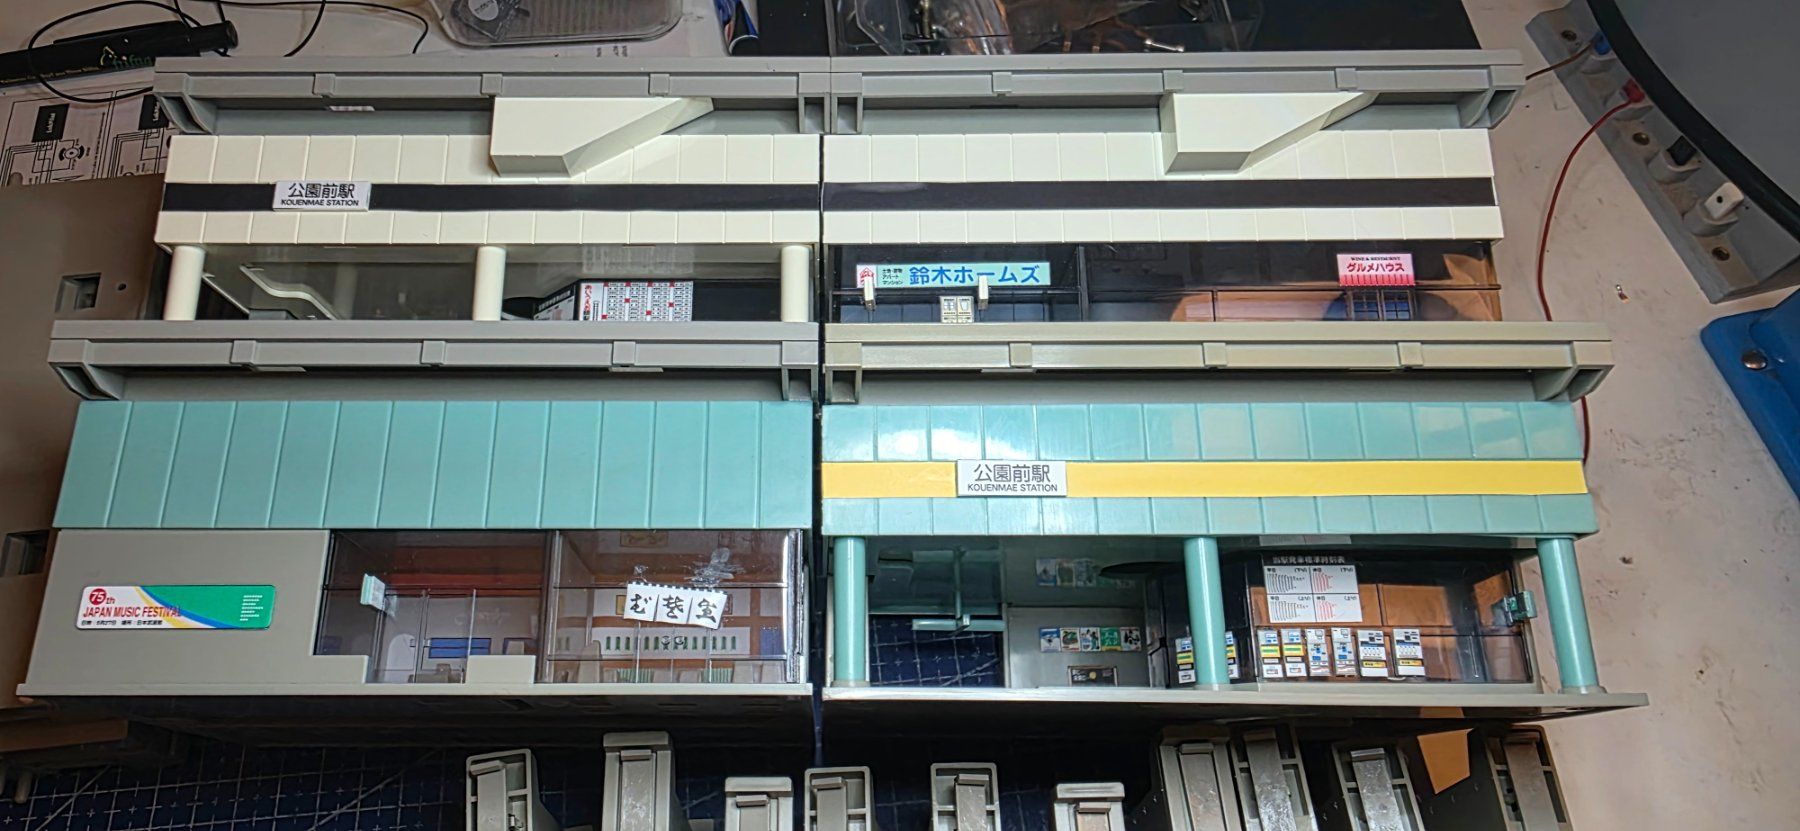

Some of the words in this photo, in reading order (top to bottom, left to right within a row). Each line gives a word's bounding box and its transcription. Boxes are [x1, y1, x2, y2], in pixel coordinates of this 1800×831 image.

[288, 182, 355, 199] 公園前駅
[1346, 262, 1405, 272] グルメハウス
[909, 265, 1040, 286] 鈴木ホームズ
[973, 463, 1051, 483] 公園前駅
[967, 483, 1018, 492] KOUENMAE
[1020, 483, 1058, 492] STATION
[83, 607, 113, 617] JAPAN
[114, 607, 141, 617] MUSIC
[142, 606, 181, 617] FESTIVAL
